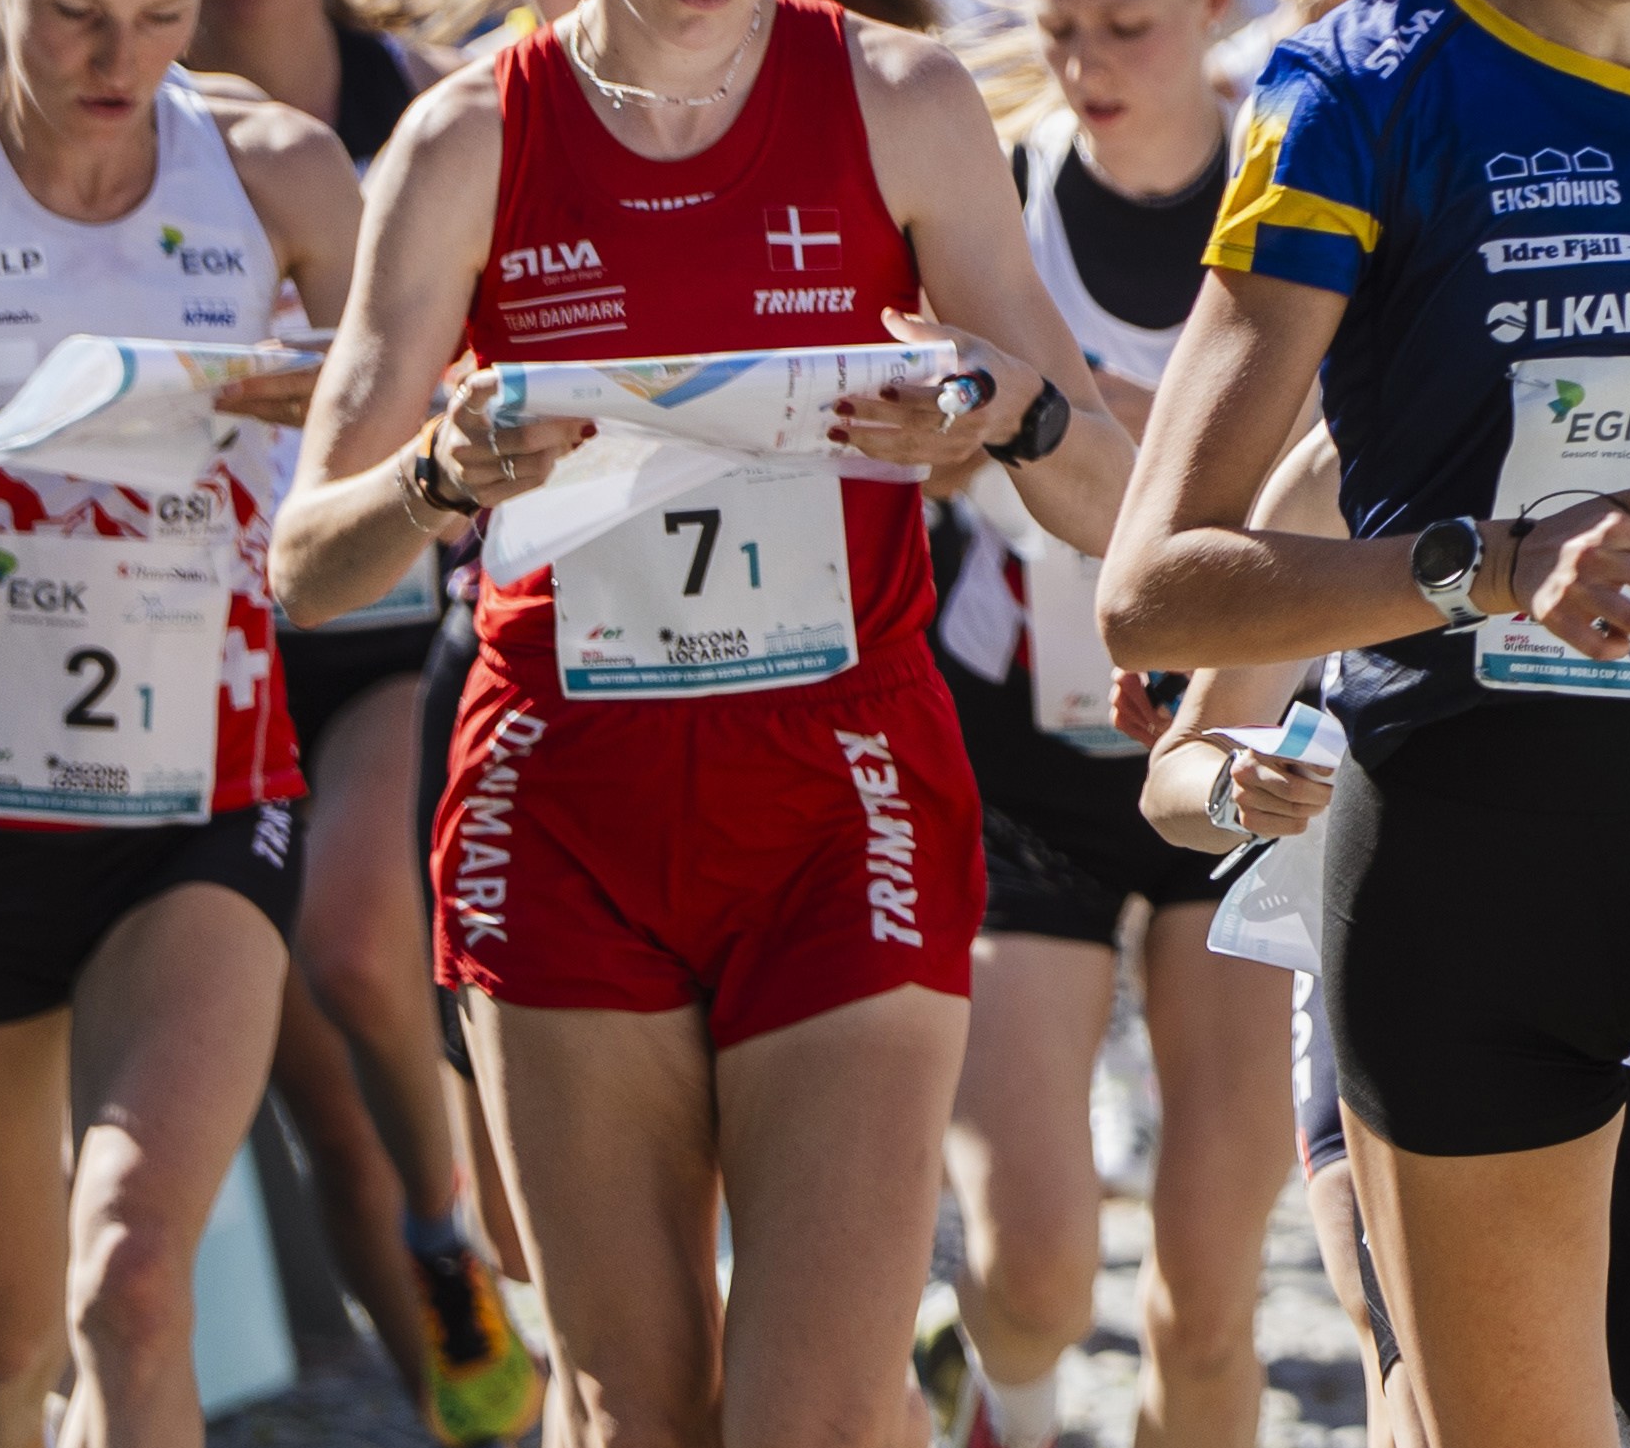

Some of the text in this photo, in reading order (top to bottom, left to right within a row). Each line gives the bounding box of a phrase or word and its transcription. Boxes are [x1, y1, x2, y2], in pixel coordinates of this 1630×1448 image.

[1491, 177, 1622, 215] EKSJÖHUS
[180, 248, 248, 276] EGK
[500, 238, 602, 283] SILVA
[1503, 238, 1623, 263] Idre Fjäll
[503, 298, 626, 332] TEAM DANMARK
[754, 287, 856, 315] TRIMTEX
[664, 508, 762, 598] 7 1
[8, 578, 88, 613] EGK
[668, 644, 749, 665] LOCARNO
[678, 628, 748, 651] ASCONA
[64, 646, 154, 732] 2 1
[455, 708, 549, 947] DANMARK
[834, 728, 924, 949] TRIMTEX
